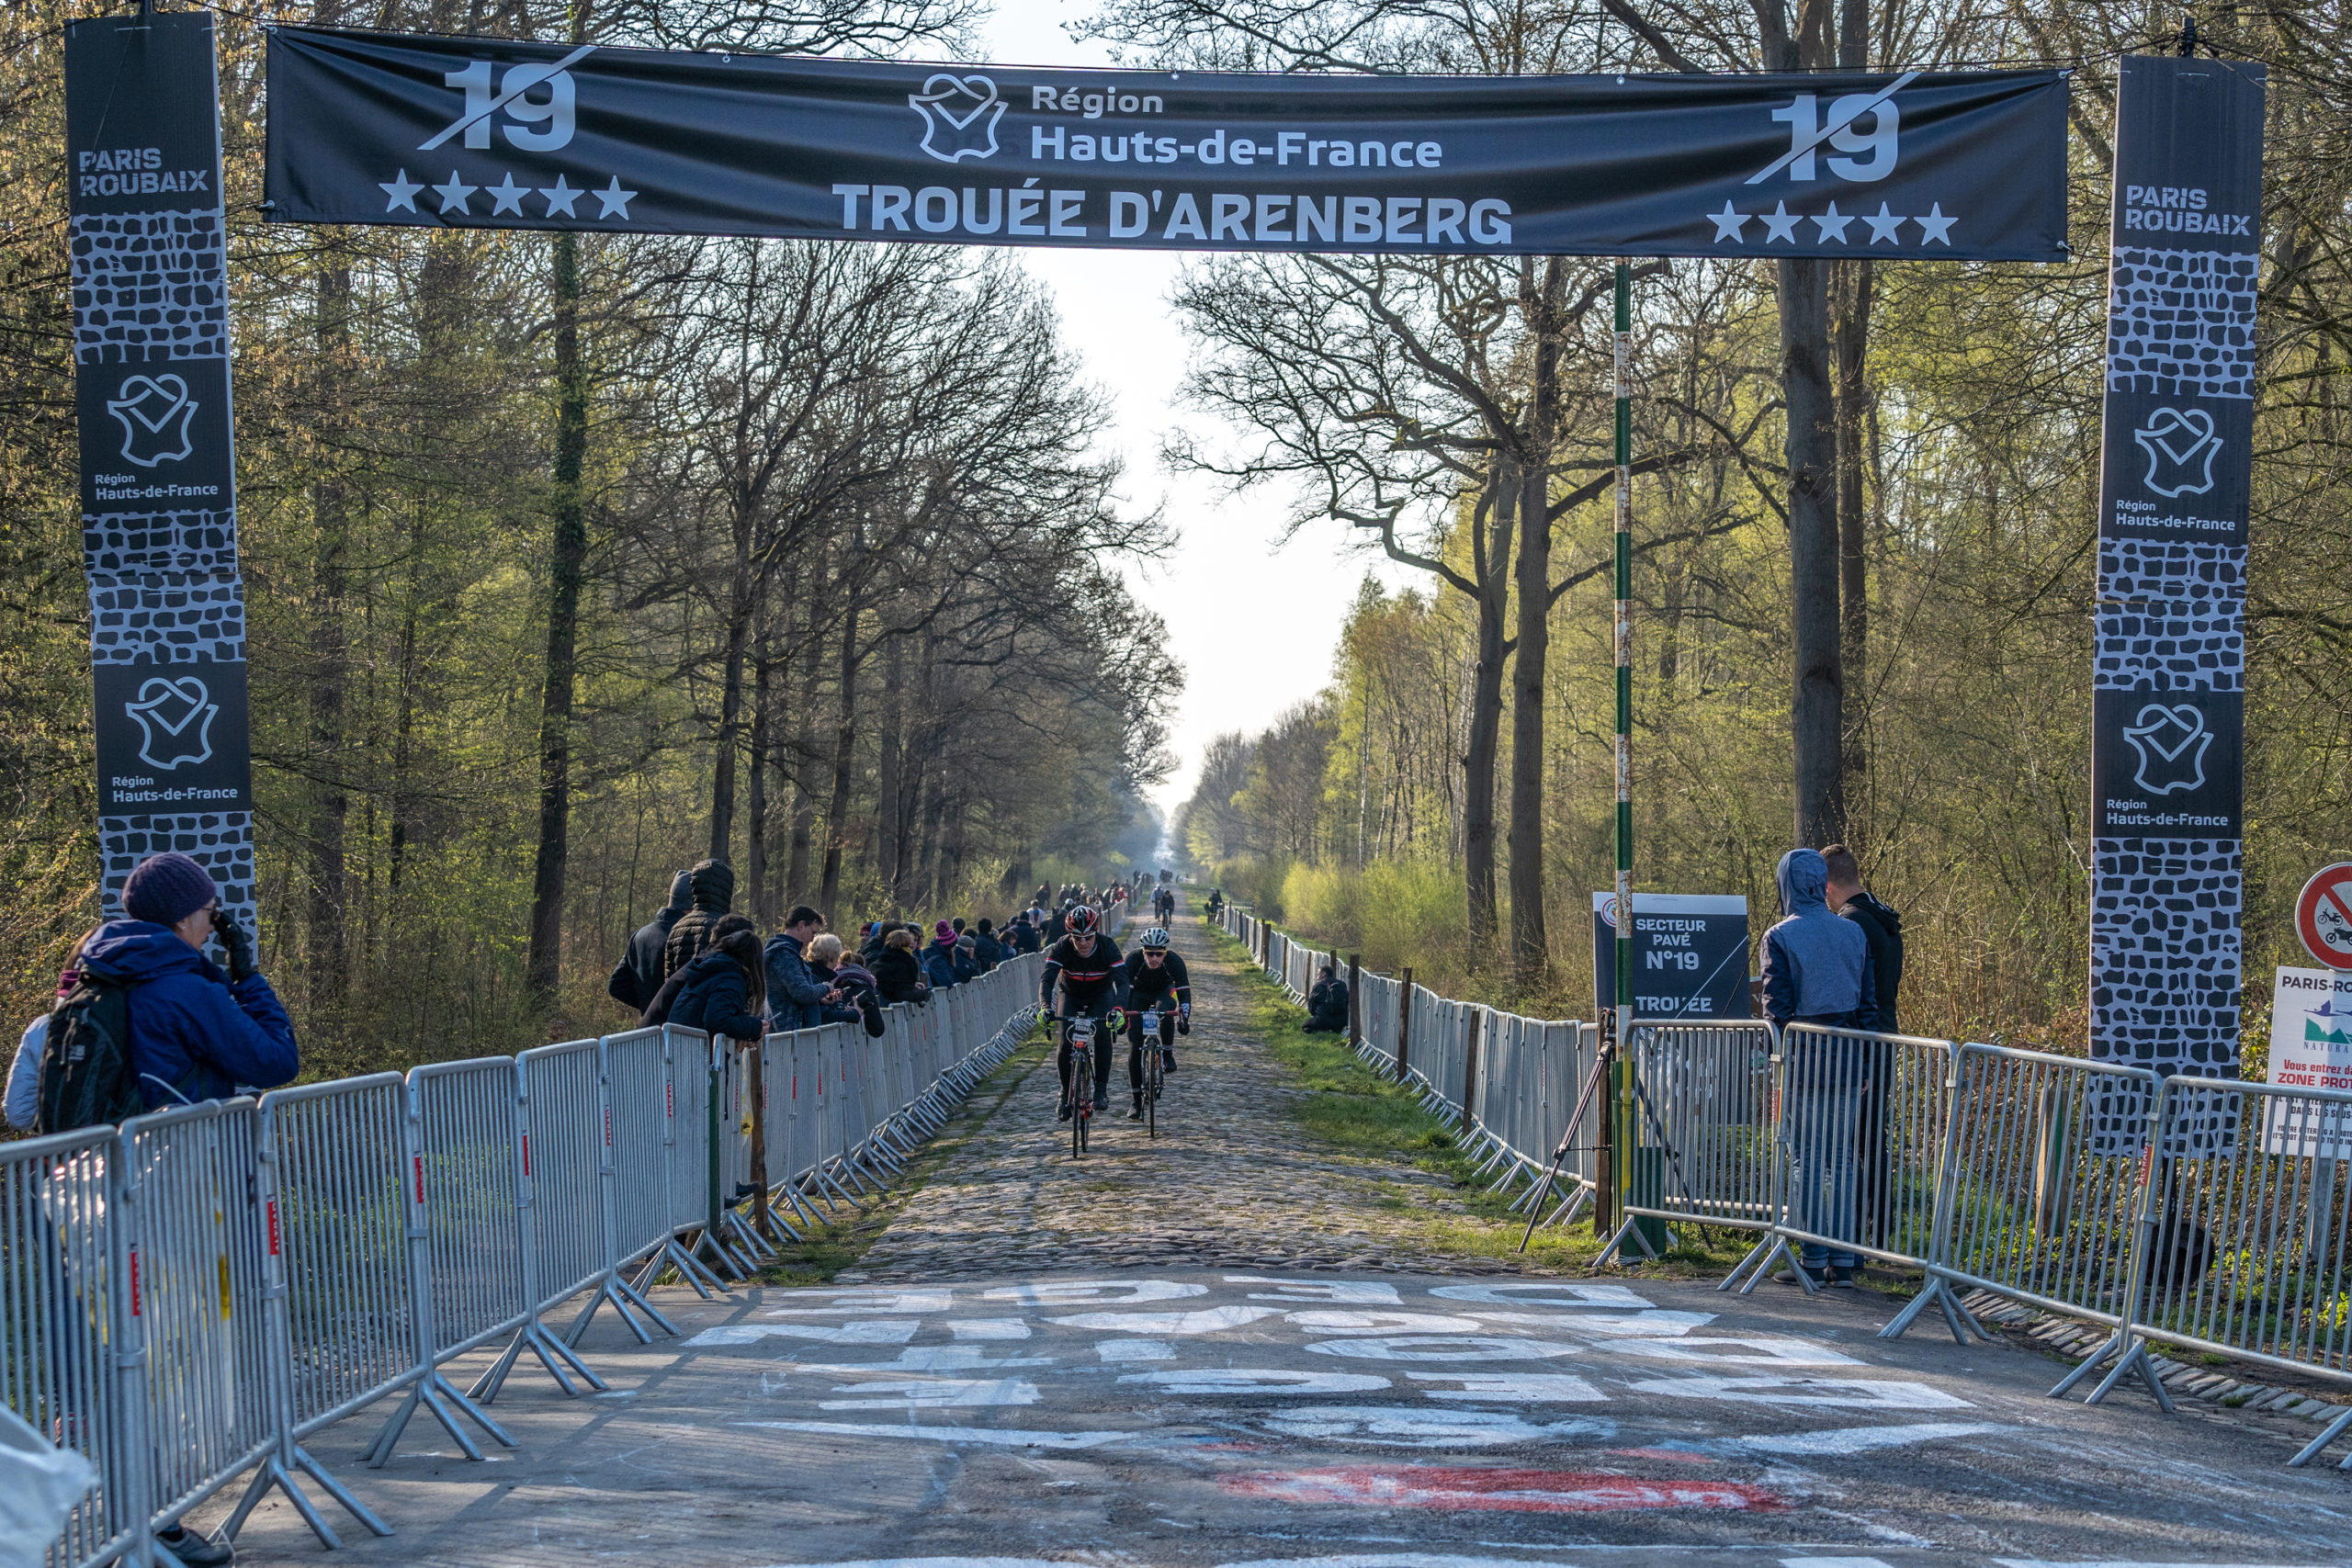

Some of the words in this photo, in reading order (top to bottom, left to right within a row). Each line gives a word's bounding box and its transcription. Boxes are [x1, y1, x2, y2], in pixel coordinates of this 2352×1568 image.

[444, 60, 577, 153] 19
[1031, 85, 1164, 120] Région
[1030, 125, 1444, 169] Hauts-de-France
[1770, 93, 1901, 184] 19
[79, 147, 163, 173] PARIS
[79, 169, 209, 197] ROUBAIX
[2125, 185, 2209, 211] PARIS
[831, 177, 1088, 238] TROUÉE
[1108, 189, 1514, 245] D'ARENBERG
[2124, 208, 2251, 237] ROUBAIX
[95, 472, 137, 486] Région
[95, 482, 220, 501] Hauts-de-France
[2116, 498, 2156, 513] Région
[2115, 512, 2237, 533] Hauts-de-France
[112, 774, 155, 789] Région
[111, 785, 240, 803] Hauts-de-France
[2106, 797, 2148, 812] Région
[2106, 809, 2230, 828] Hauts-de-France
[1635, 919, 1706, 932] SECTEUR
[1652, 932, 1691, 946] PAVÉ
[1646, 951, 1700, 970] N°19
[2282, 975, 2352, 994] PARIS-RO
[2302, 1041, 2349, 1055] NATURA
[2284, 1059, 2307, 1072] Vous
[2310, 1064, 2342, 1075] entrez
[2278, 1073, 2316, 1086] ZONE
[2290, 1106, 2313, 1116] DAS
[2315, 1108, 2329, 1117] LS
